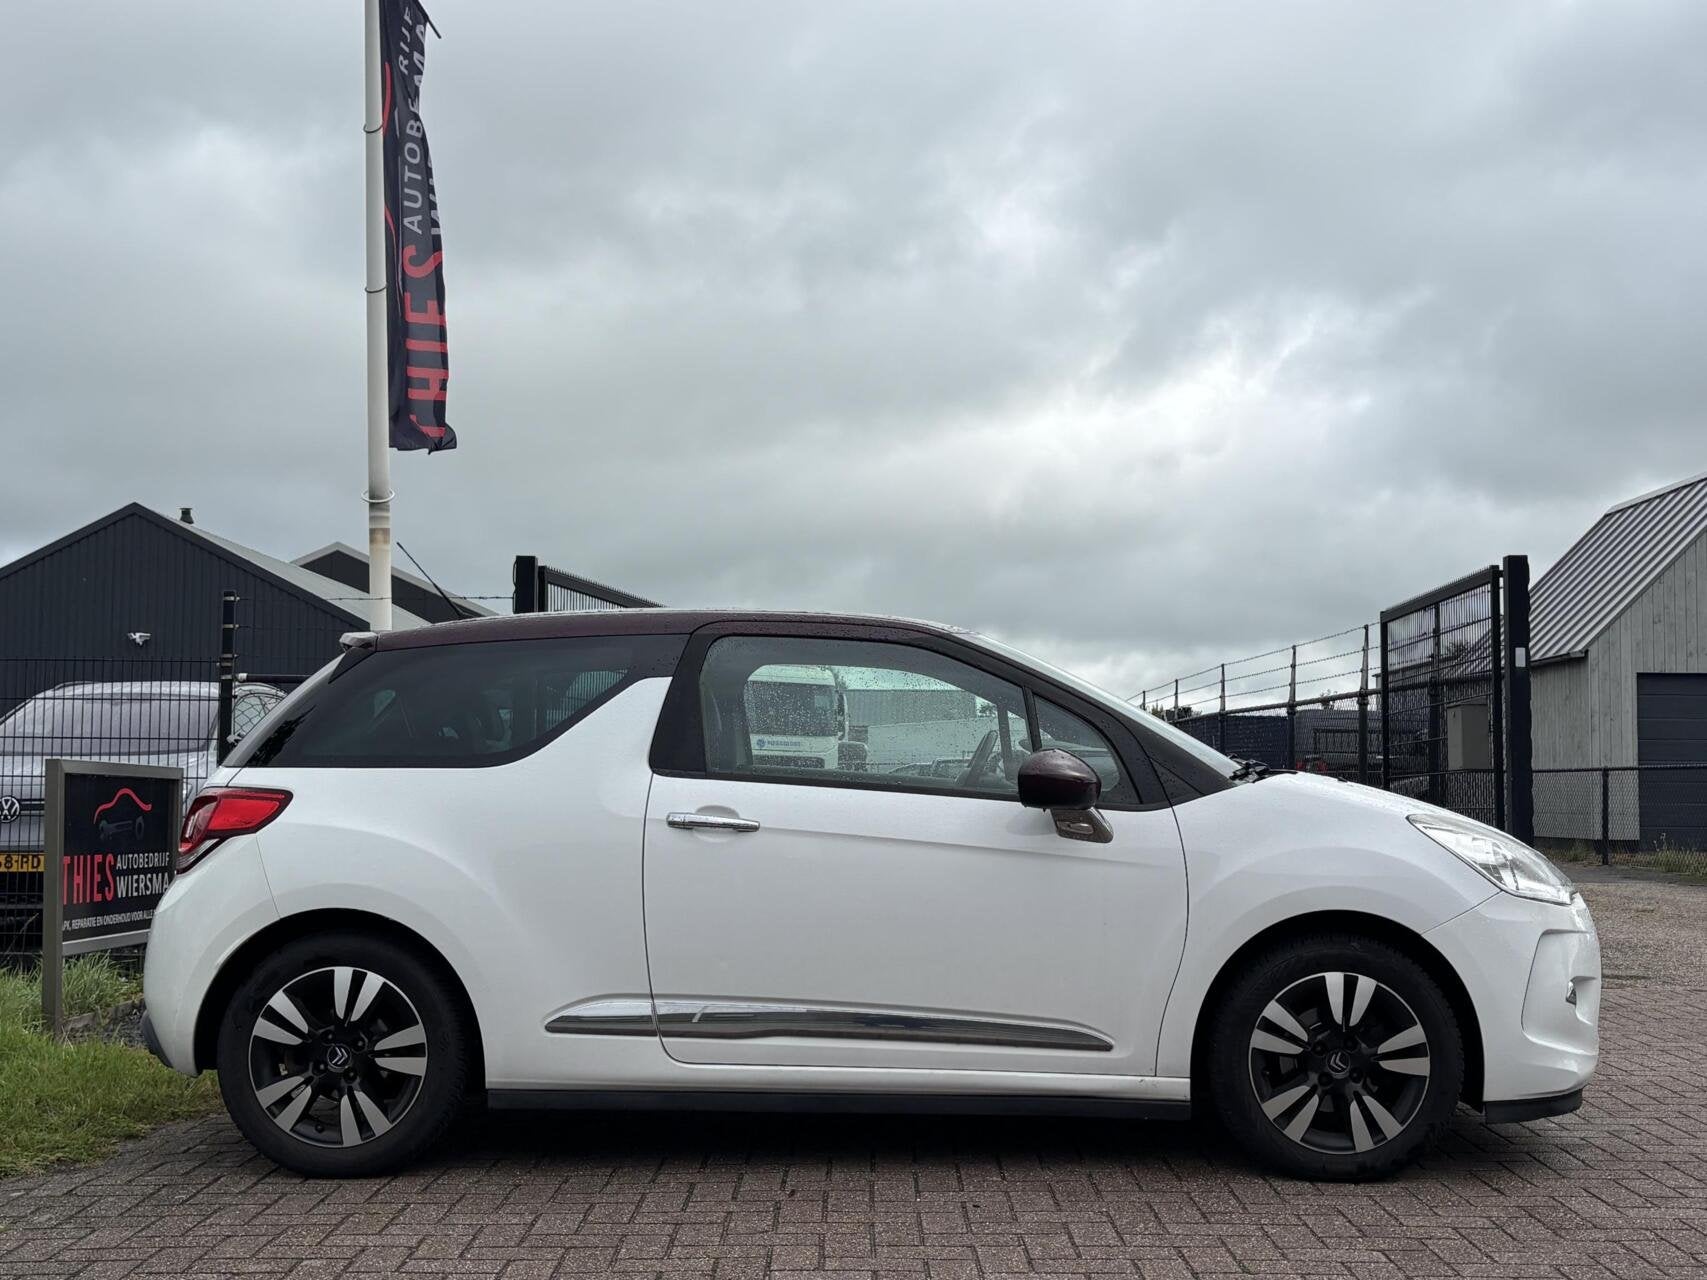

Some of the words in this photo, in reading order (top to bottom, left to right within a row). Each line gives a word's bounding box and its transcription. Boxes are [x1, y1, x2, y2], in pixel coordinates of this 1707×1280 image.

[399, 6, 423, 235] AUTOBERIJF
[116, 852, 170, 870] AUTOBEDRIJF
[63, 853, 115, 905] THIES
[116, 872, 169, 898] WIERSMA
[104, 912, 131, 925] ONDERHOUD
